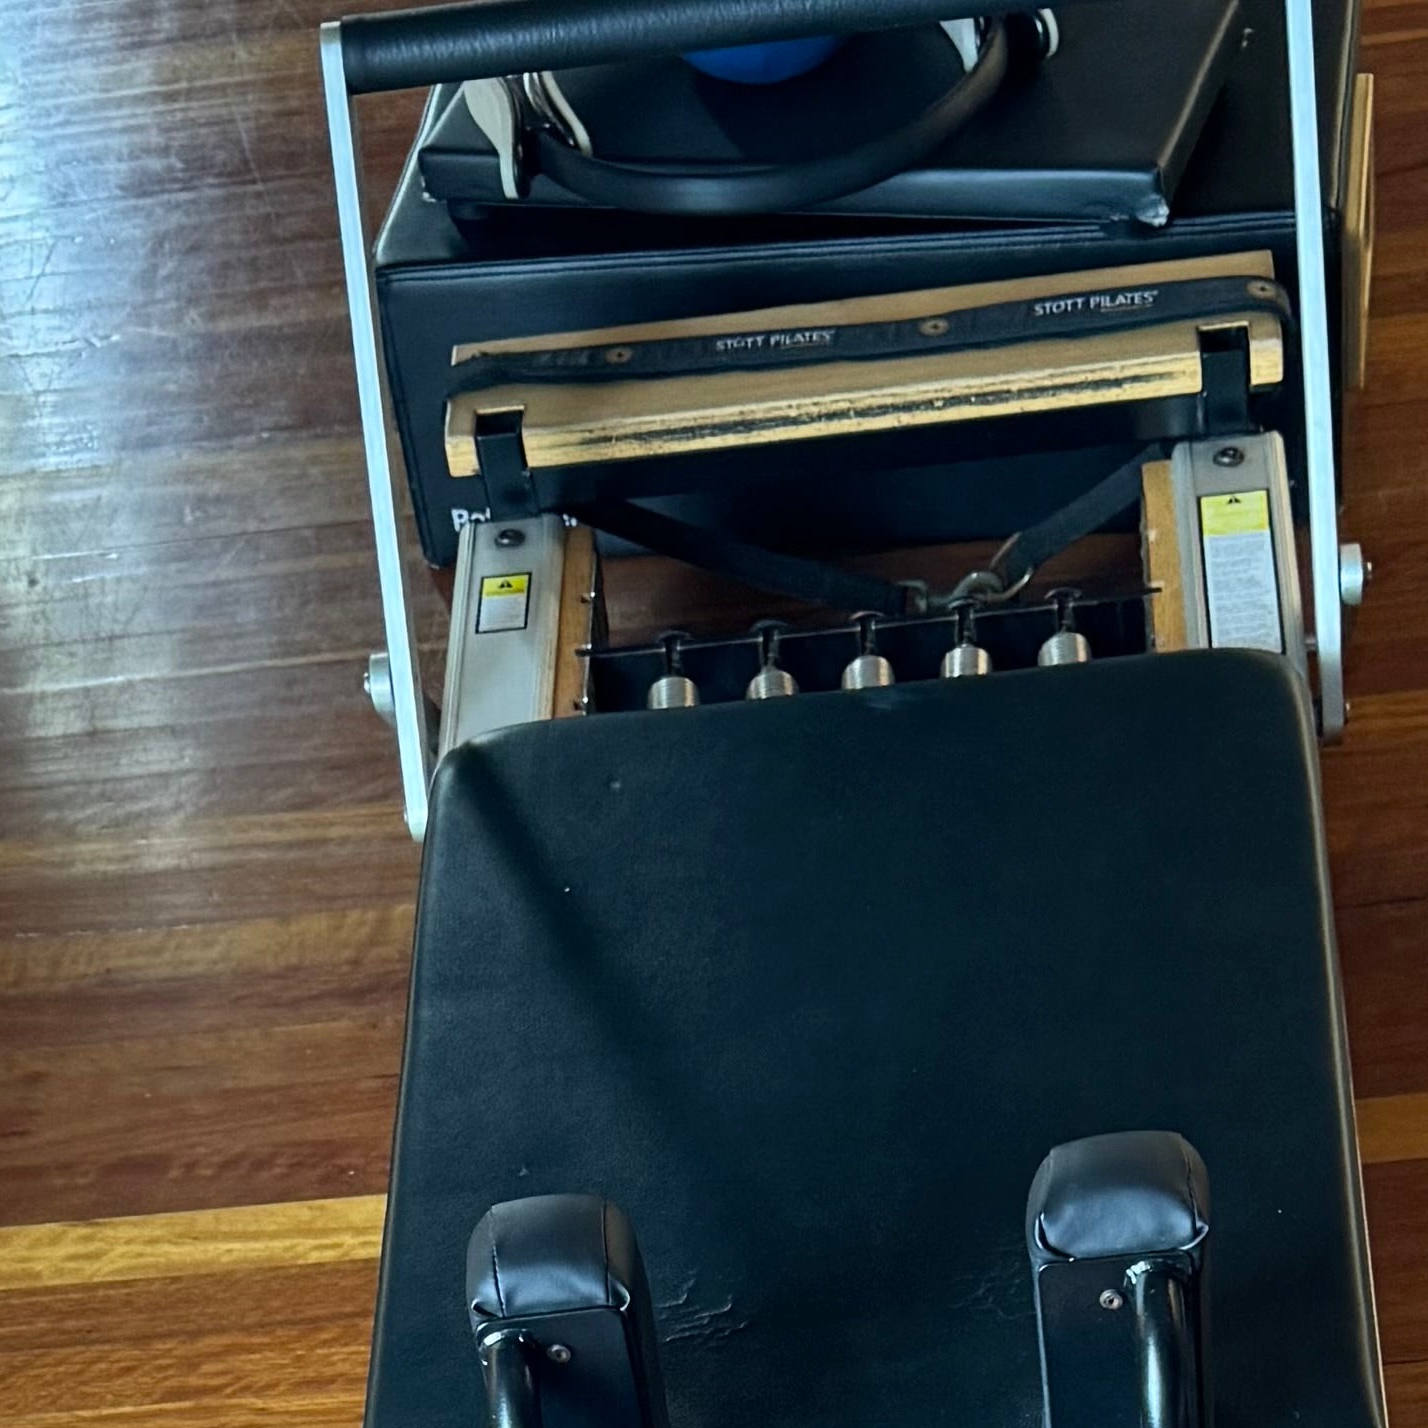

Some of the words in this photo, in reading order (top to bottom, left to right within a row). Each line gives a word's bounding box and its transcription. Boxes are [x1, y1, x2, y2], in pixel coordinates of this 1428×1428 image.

[1033, 297, 1086, 317] STOTT
[1089, 290, 1155, 310] PILATES
[715, 335, 766, 352] STOTT
